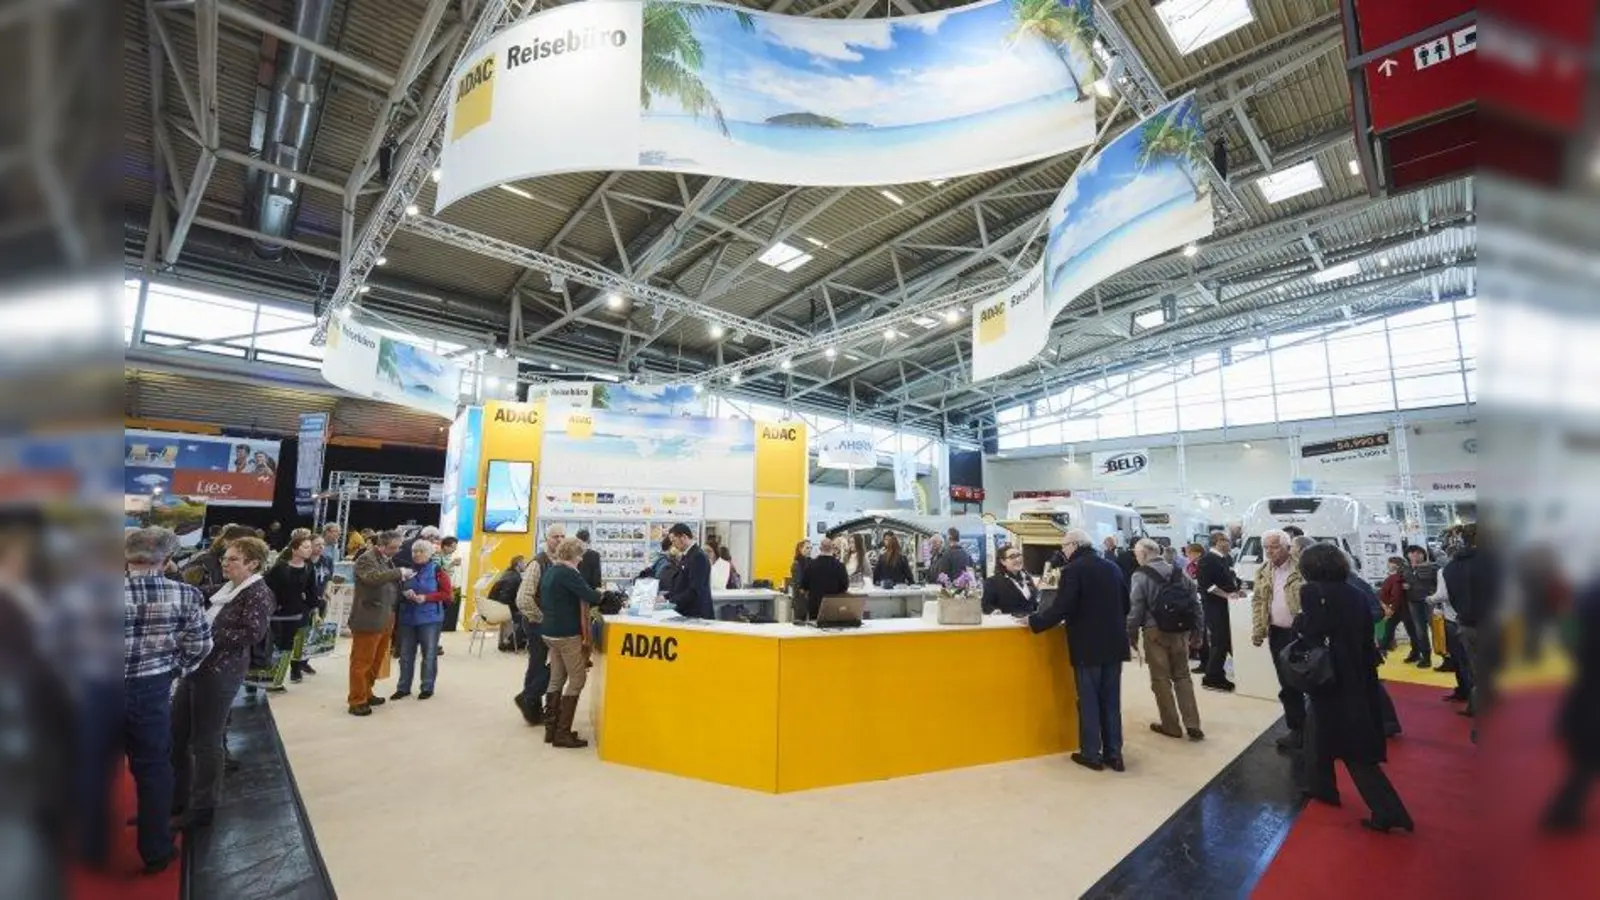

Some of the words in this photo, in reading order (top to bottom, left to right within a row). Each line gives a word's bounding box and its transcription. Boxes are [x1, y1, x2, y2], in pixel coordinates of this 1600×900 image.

[456, 58, 494, 104] ADAC
[979, 301, 1006, 324] ADAC
[494, 407, 539, 425] ADAC
[762, 426, 797, 441] ADAC
[1106, 455, 1144, 472] BELA
[621, 633, 679, 663] ADAC
